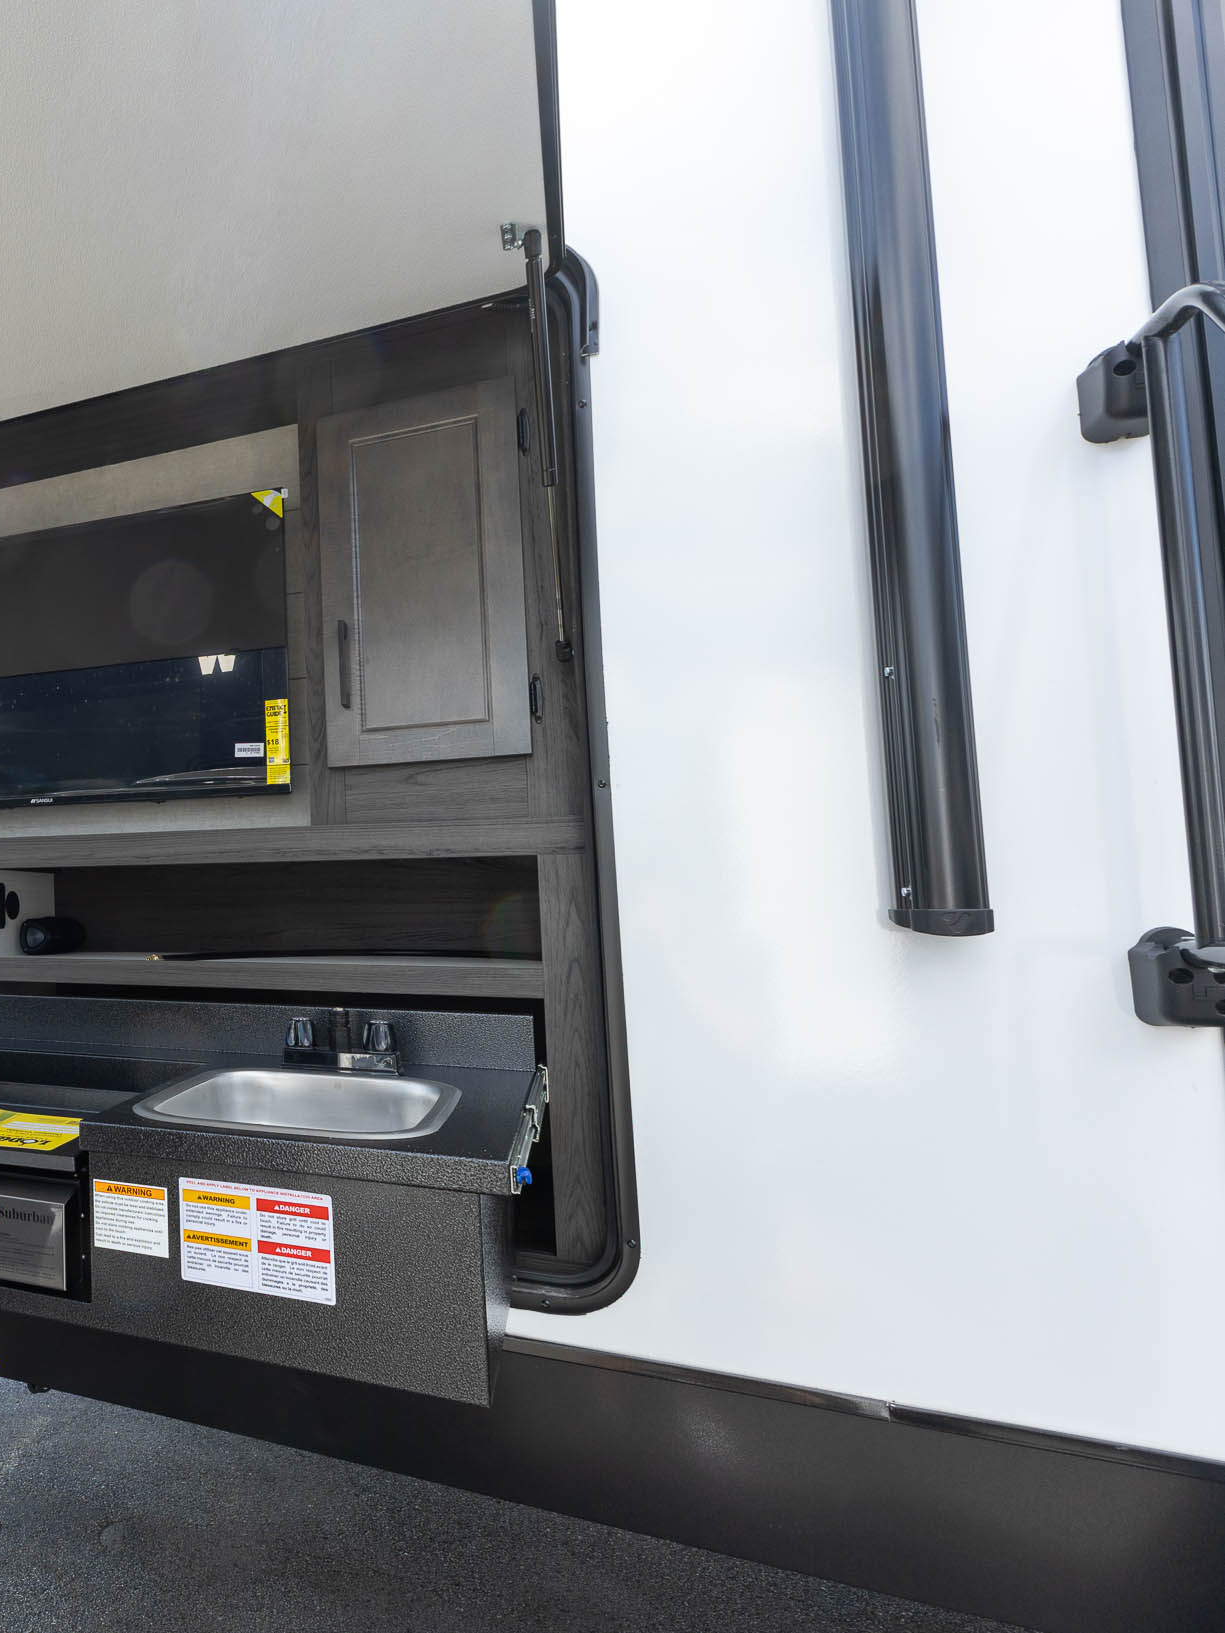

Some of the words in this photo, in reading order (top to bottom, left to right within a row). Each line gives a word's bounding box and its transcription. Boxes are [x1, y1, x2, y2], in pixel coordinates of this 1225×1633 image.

[114, 1185, 152, 1197] WARNING
[202, 1195, 235, 1204] WARNING
[280, 1205, 311, 1214] DANGER
[192, 1235, 248, 1247] AVERTISSEMENT
[281, 1247, 312, 1257] DANGER
